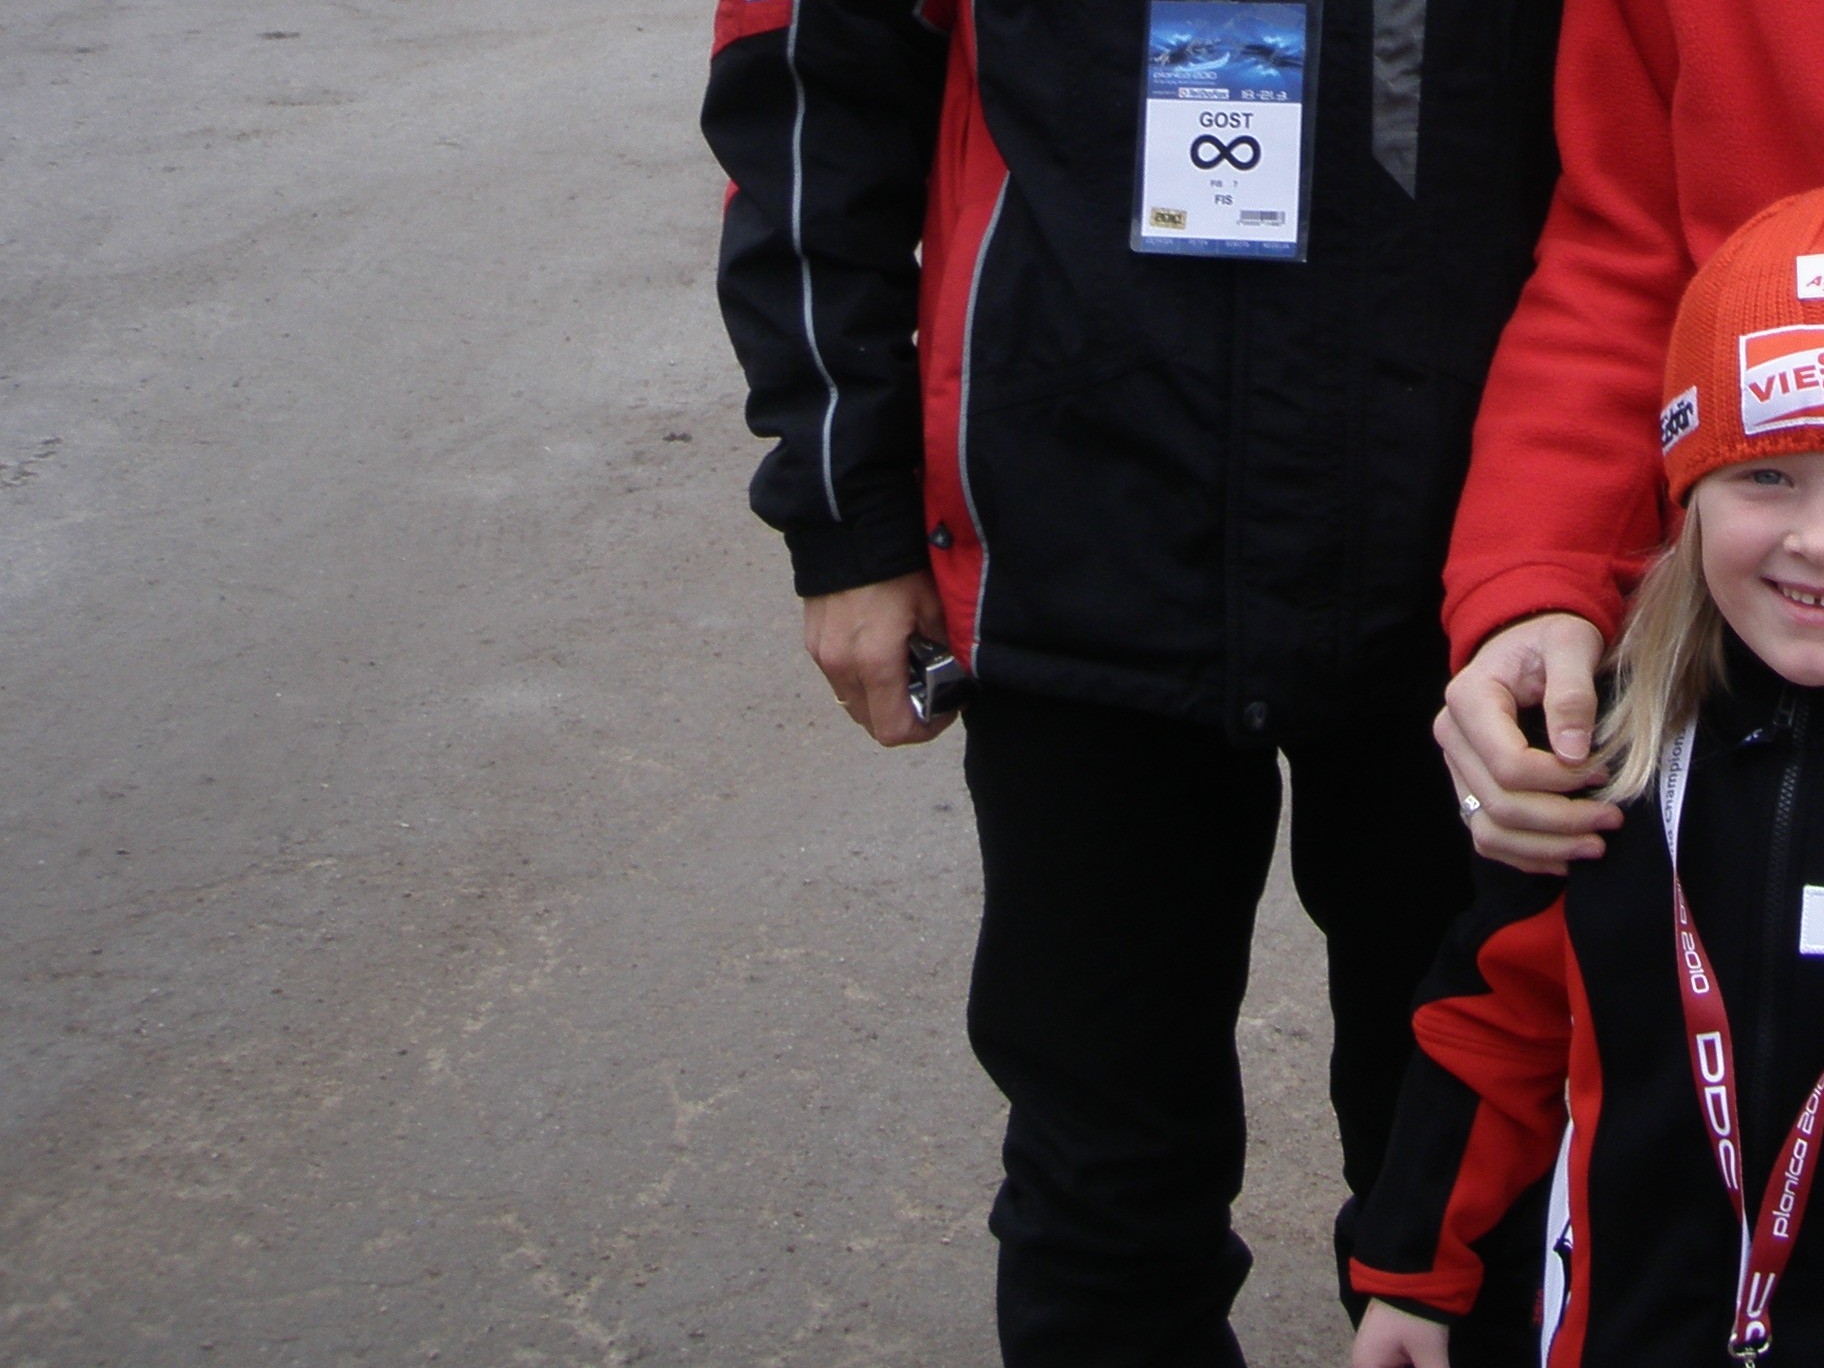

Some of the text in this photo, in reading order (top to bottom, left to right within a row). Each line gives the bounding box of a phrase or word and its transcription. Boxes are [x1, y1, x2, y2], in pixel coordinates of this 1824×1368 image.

[1199, 111, 1254, 130] GOST
[1214, 194, 1233, 206] FIS
[1681, 931, 1709, 994] 2010
[1773, 1137, 1808, 1238] planica
